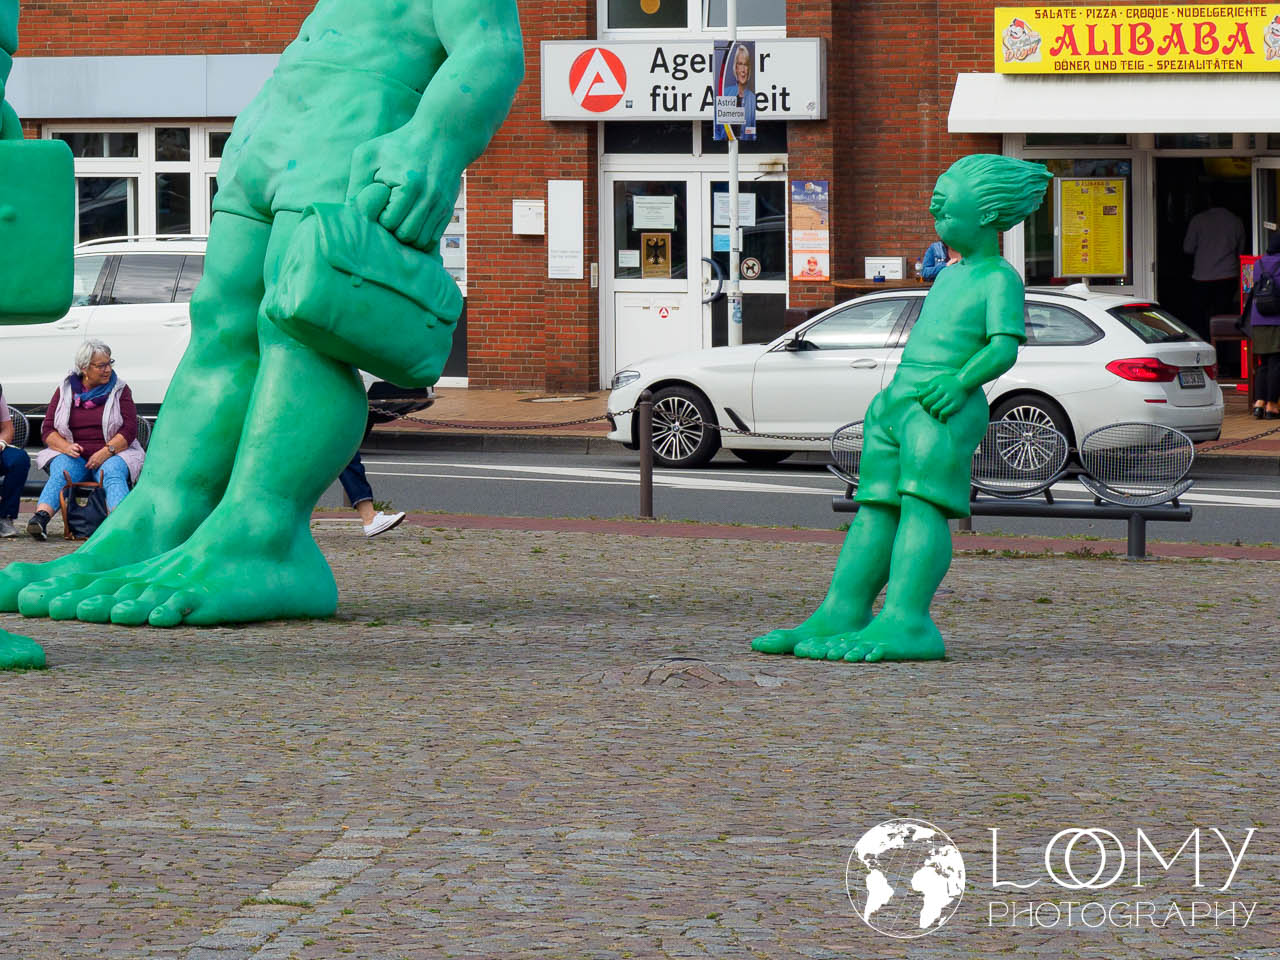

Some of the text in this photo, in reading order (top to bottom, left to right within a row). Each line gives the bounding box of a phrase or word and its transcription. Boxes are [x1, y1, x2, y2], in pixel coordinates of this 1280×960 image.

[1034, 7, 1267, 20] SALATE PIZZA CROQUE NUDELGERICHTE
[1049, 21, 1255, 56] ALIBABA
[649, 47, 771, 81] Ager
[1054, 58, 1243, 71] DÖNER UND TEIG SPEZIALITÄTEN
[650, 85, 790, 112] für Aeit
[717, 98, 736, 107] Astrid
